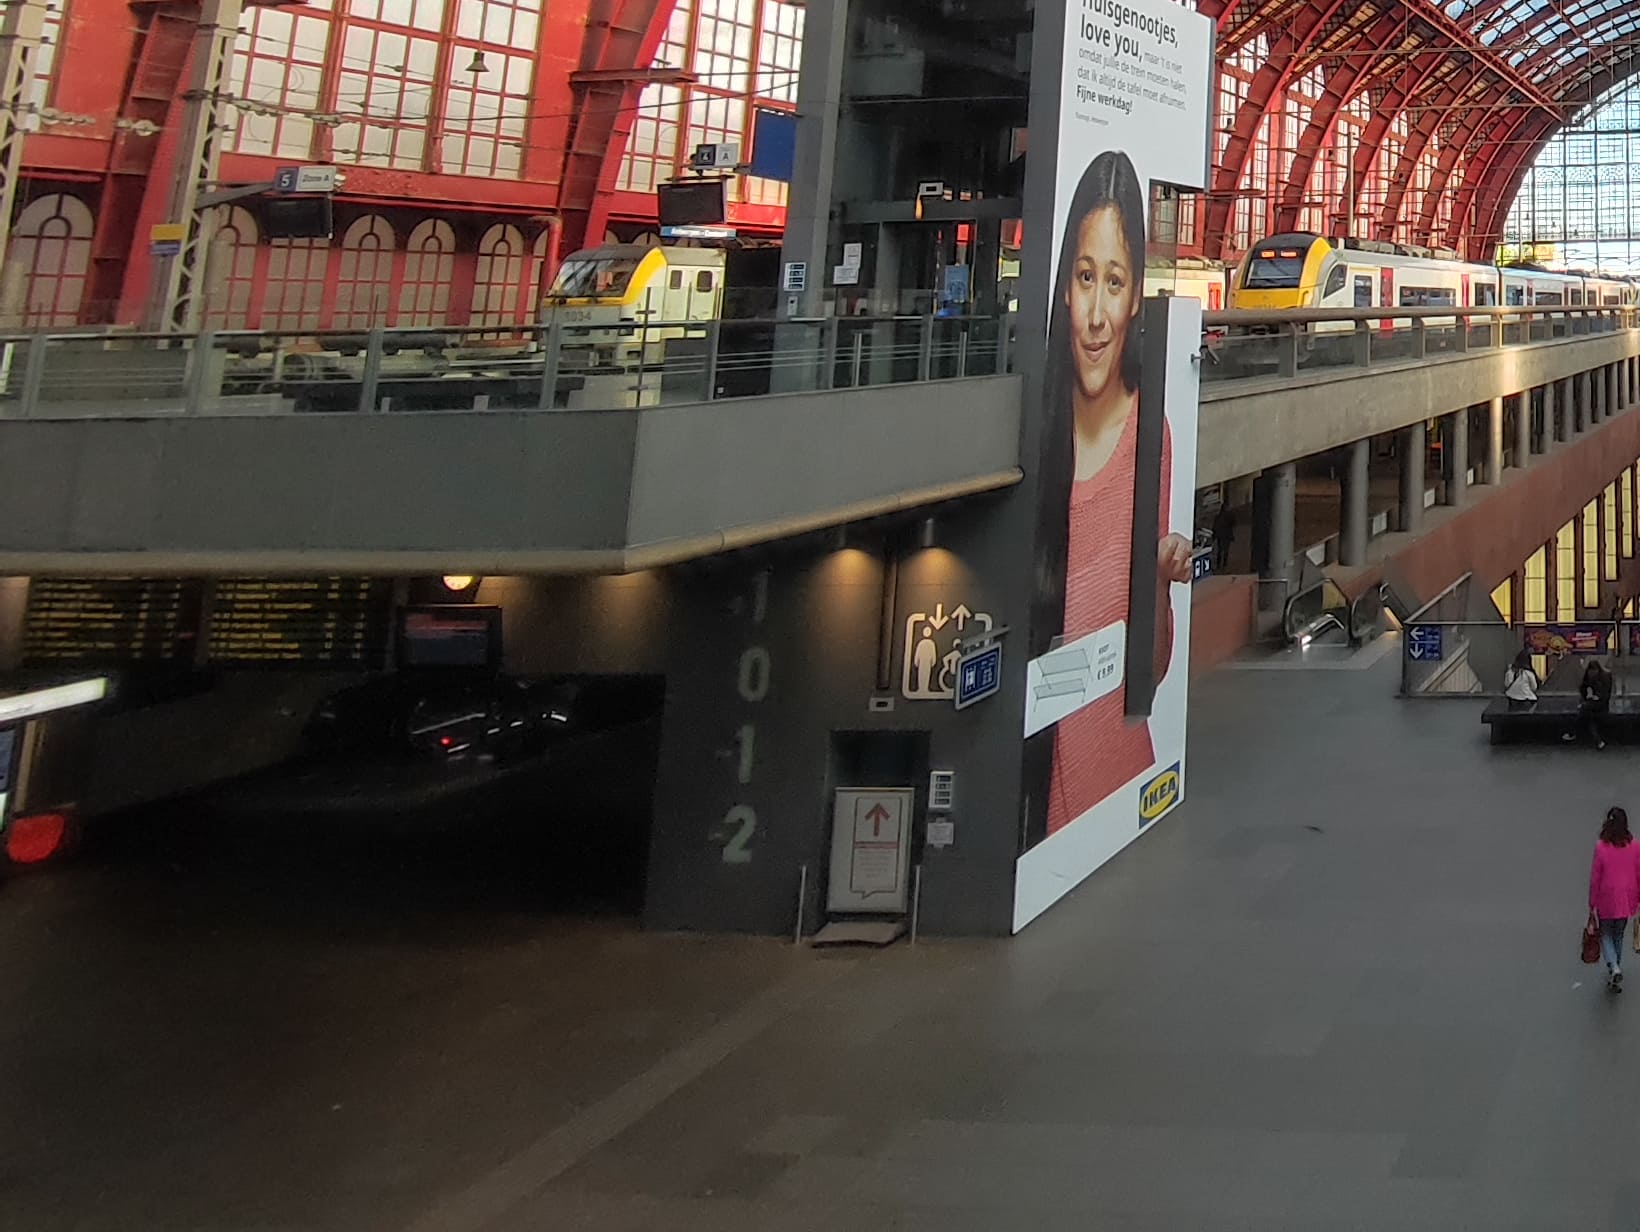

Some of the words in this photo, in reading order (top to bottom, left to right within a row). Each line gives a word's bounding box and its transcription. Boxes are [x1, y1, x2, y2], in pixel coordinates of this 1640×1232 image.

[1080, 13, 1111, 48] love
[1113, 31, 1143, 63] you,
[1078, 48, 1102, 65] omdat
[1120, 61, 1130, 75] de
[1077, 66, 1090, 82] dat
[1117, 79, 1127, 93] de
[1076, 84, 1097, 104] Fijne
[1097, 94, 1133, 115] werkdag!
[280, 173, 292, 188] 5
[738, 646, 772, 703] 0
[1142, 775, 1176, 812] IKEA
[708, 804, 757, 864] -2
